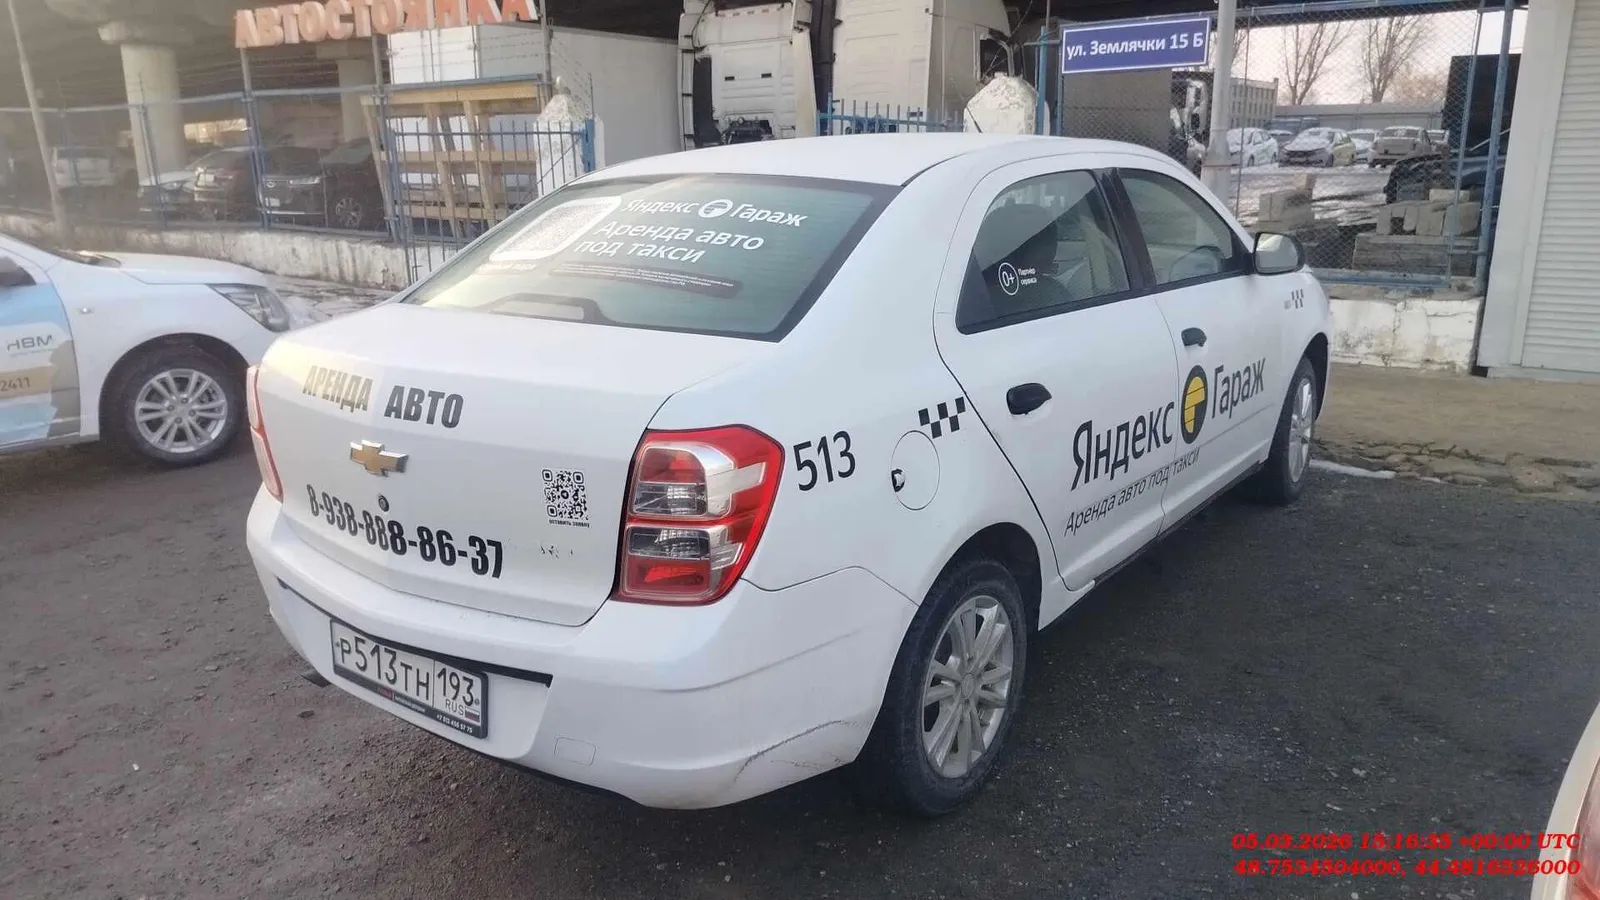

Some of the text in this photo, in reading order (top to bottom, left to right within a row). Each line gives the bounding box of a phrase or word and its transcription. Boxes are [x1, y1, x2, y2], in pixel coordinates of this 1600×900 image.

[1067, 32, 1204, 60] ул. Землячки 15 Б
[594, 220, 765, 250] Аренда авто
[620, 199, 808, 227] Яндекс Гараж
[575, 240, 706, 263] под такси
[302, 365, 464, 429] АРЕНДА АВТО
[1070, 357, 1266, 491] Яндекс Гараж
[793, 430, 856, 491] 513
[1064, 446, 1201, 537] Аренда авто под такси
[306, 484, 503, 579] 8-938-888-86-37
[445, 698, 464, 717] RUS
